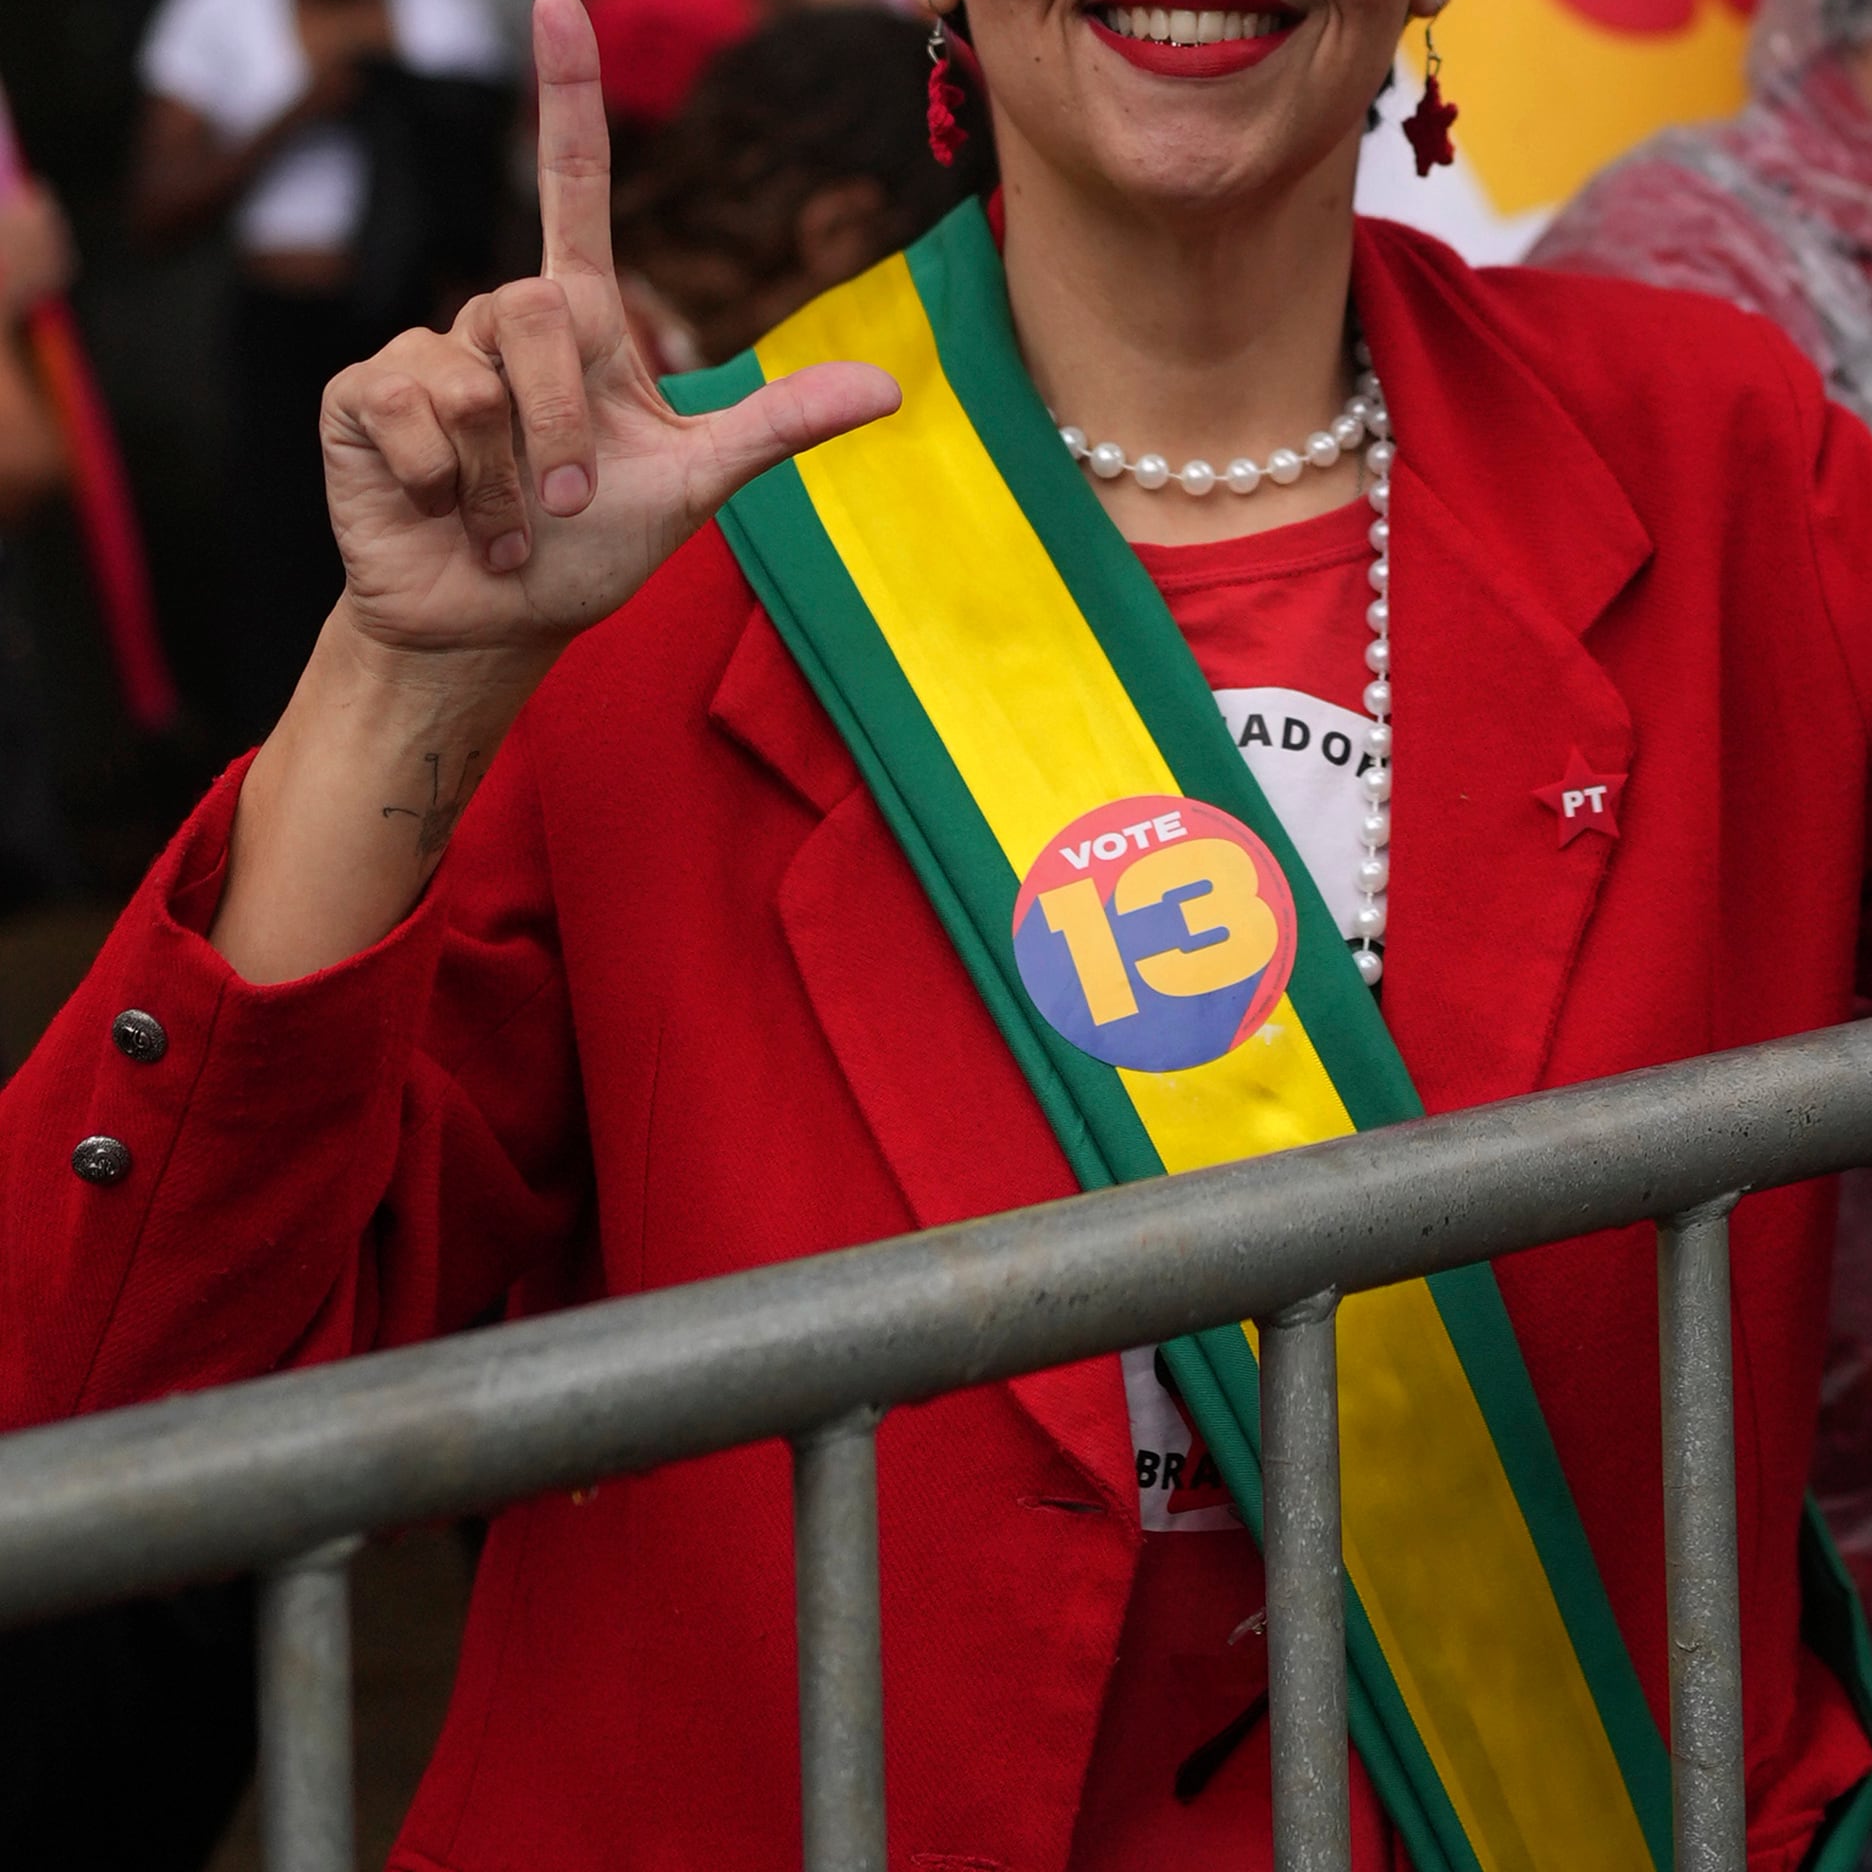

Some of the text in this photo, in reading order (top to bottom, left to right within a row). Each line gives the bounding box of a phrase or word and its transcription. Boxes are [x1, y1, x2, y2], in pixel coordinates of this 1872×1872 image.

[1561, 785, 1608, 818] PT
[1058, 810, 1189, 870] VOTE
[1036, 837, 1279, 1027] 13
